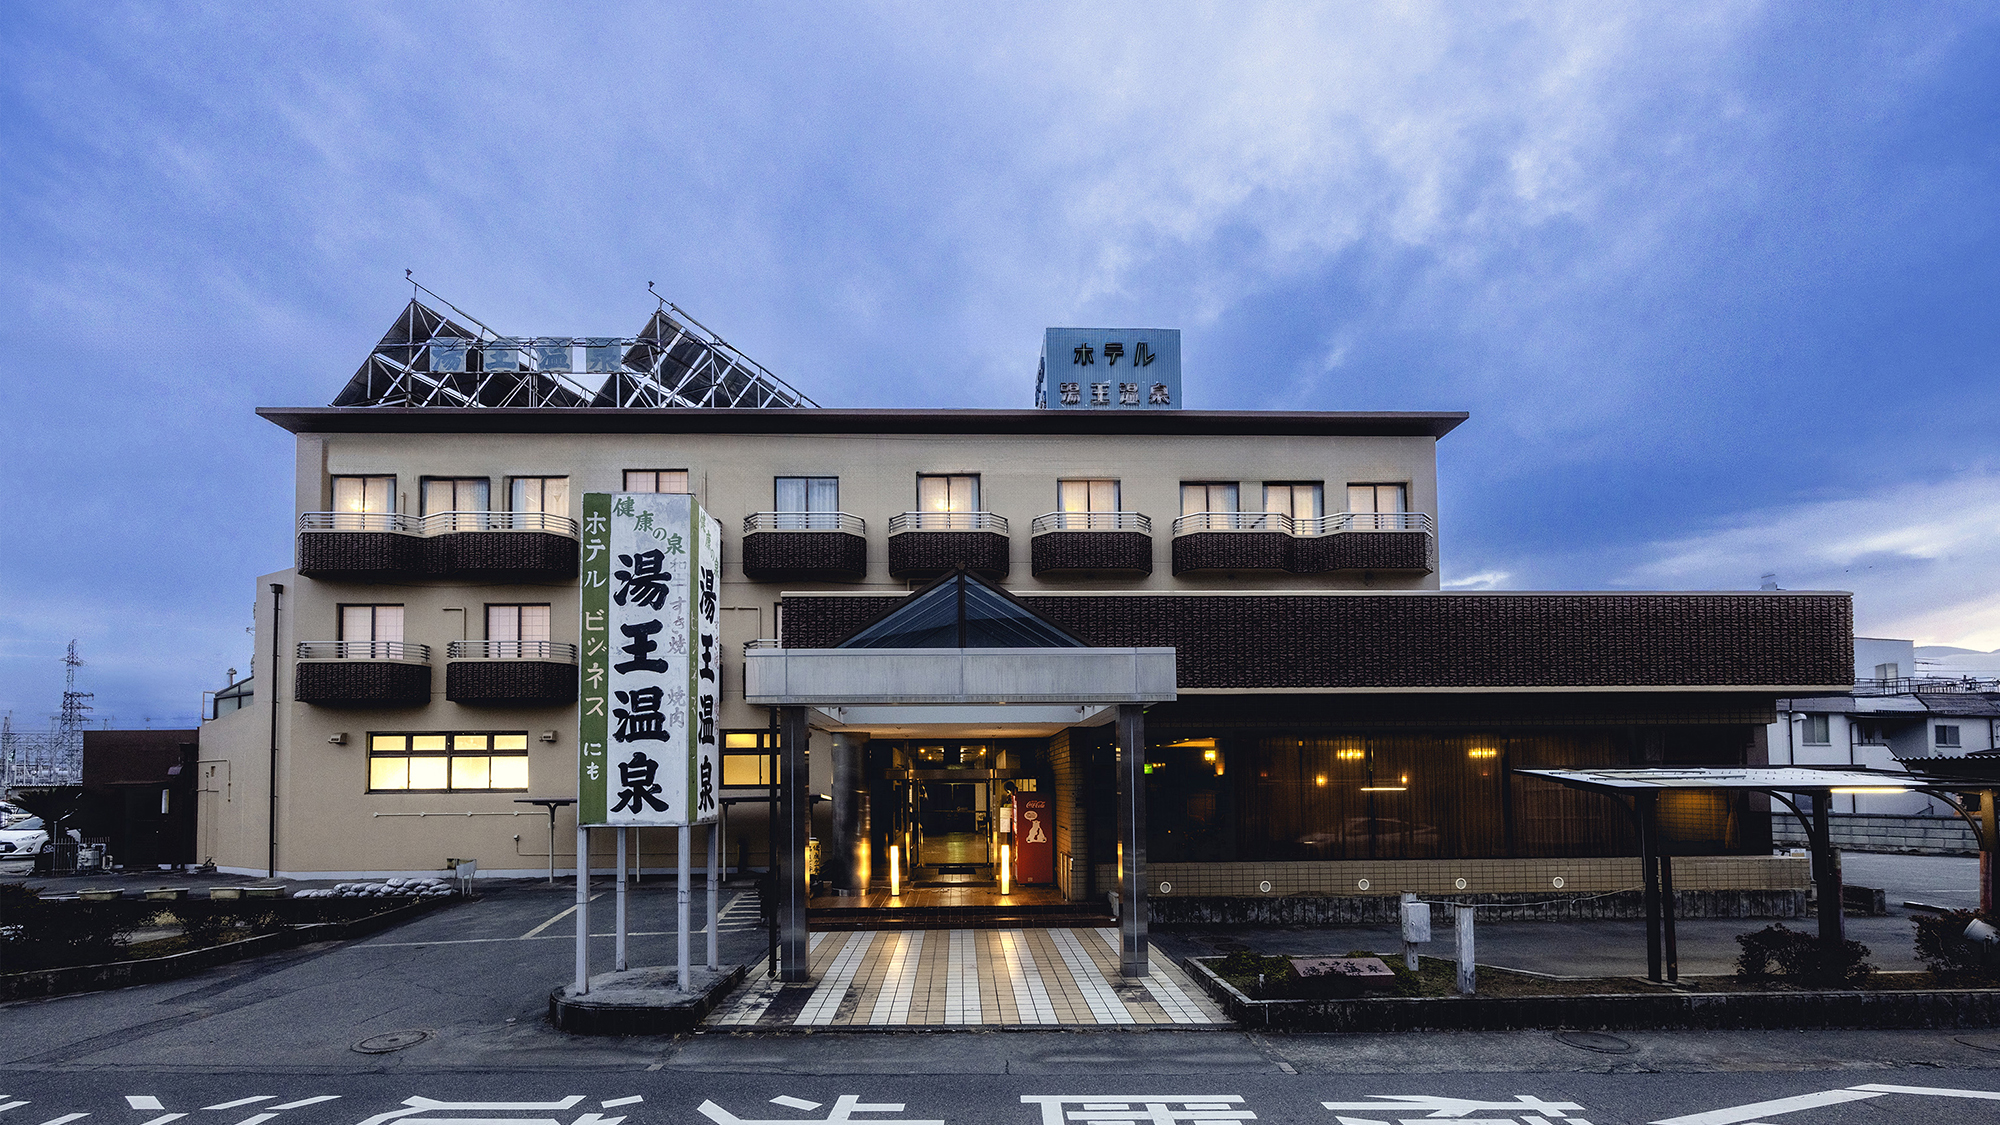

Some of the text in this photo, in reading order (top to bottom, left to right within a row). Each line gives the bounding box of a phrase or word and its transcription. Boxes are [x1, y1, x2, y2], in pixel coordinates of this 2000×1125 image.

[1074, 342, 1155, 366] ホテル
[1060, 382, 1170, 405] 湯王温泉
[612, 496, 686, 555] 健康の泉
[584, 511, 607, 780] ホテル ビジネス にも
[610, 549, 672, 814] 湯王温泉
[667, 685, 685, 728] 焼肉
[698, 566, 717, 812] 湯王温泉
